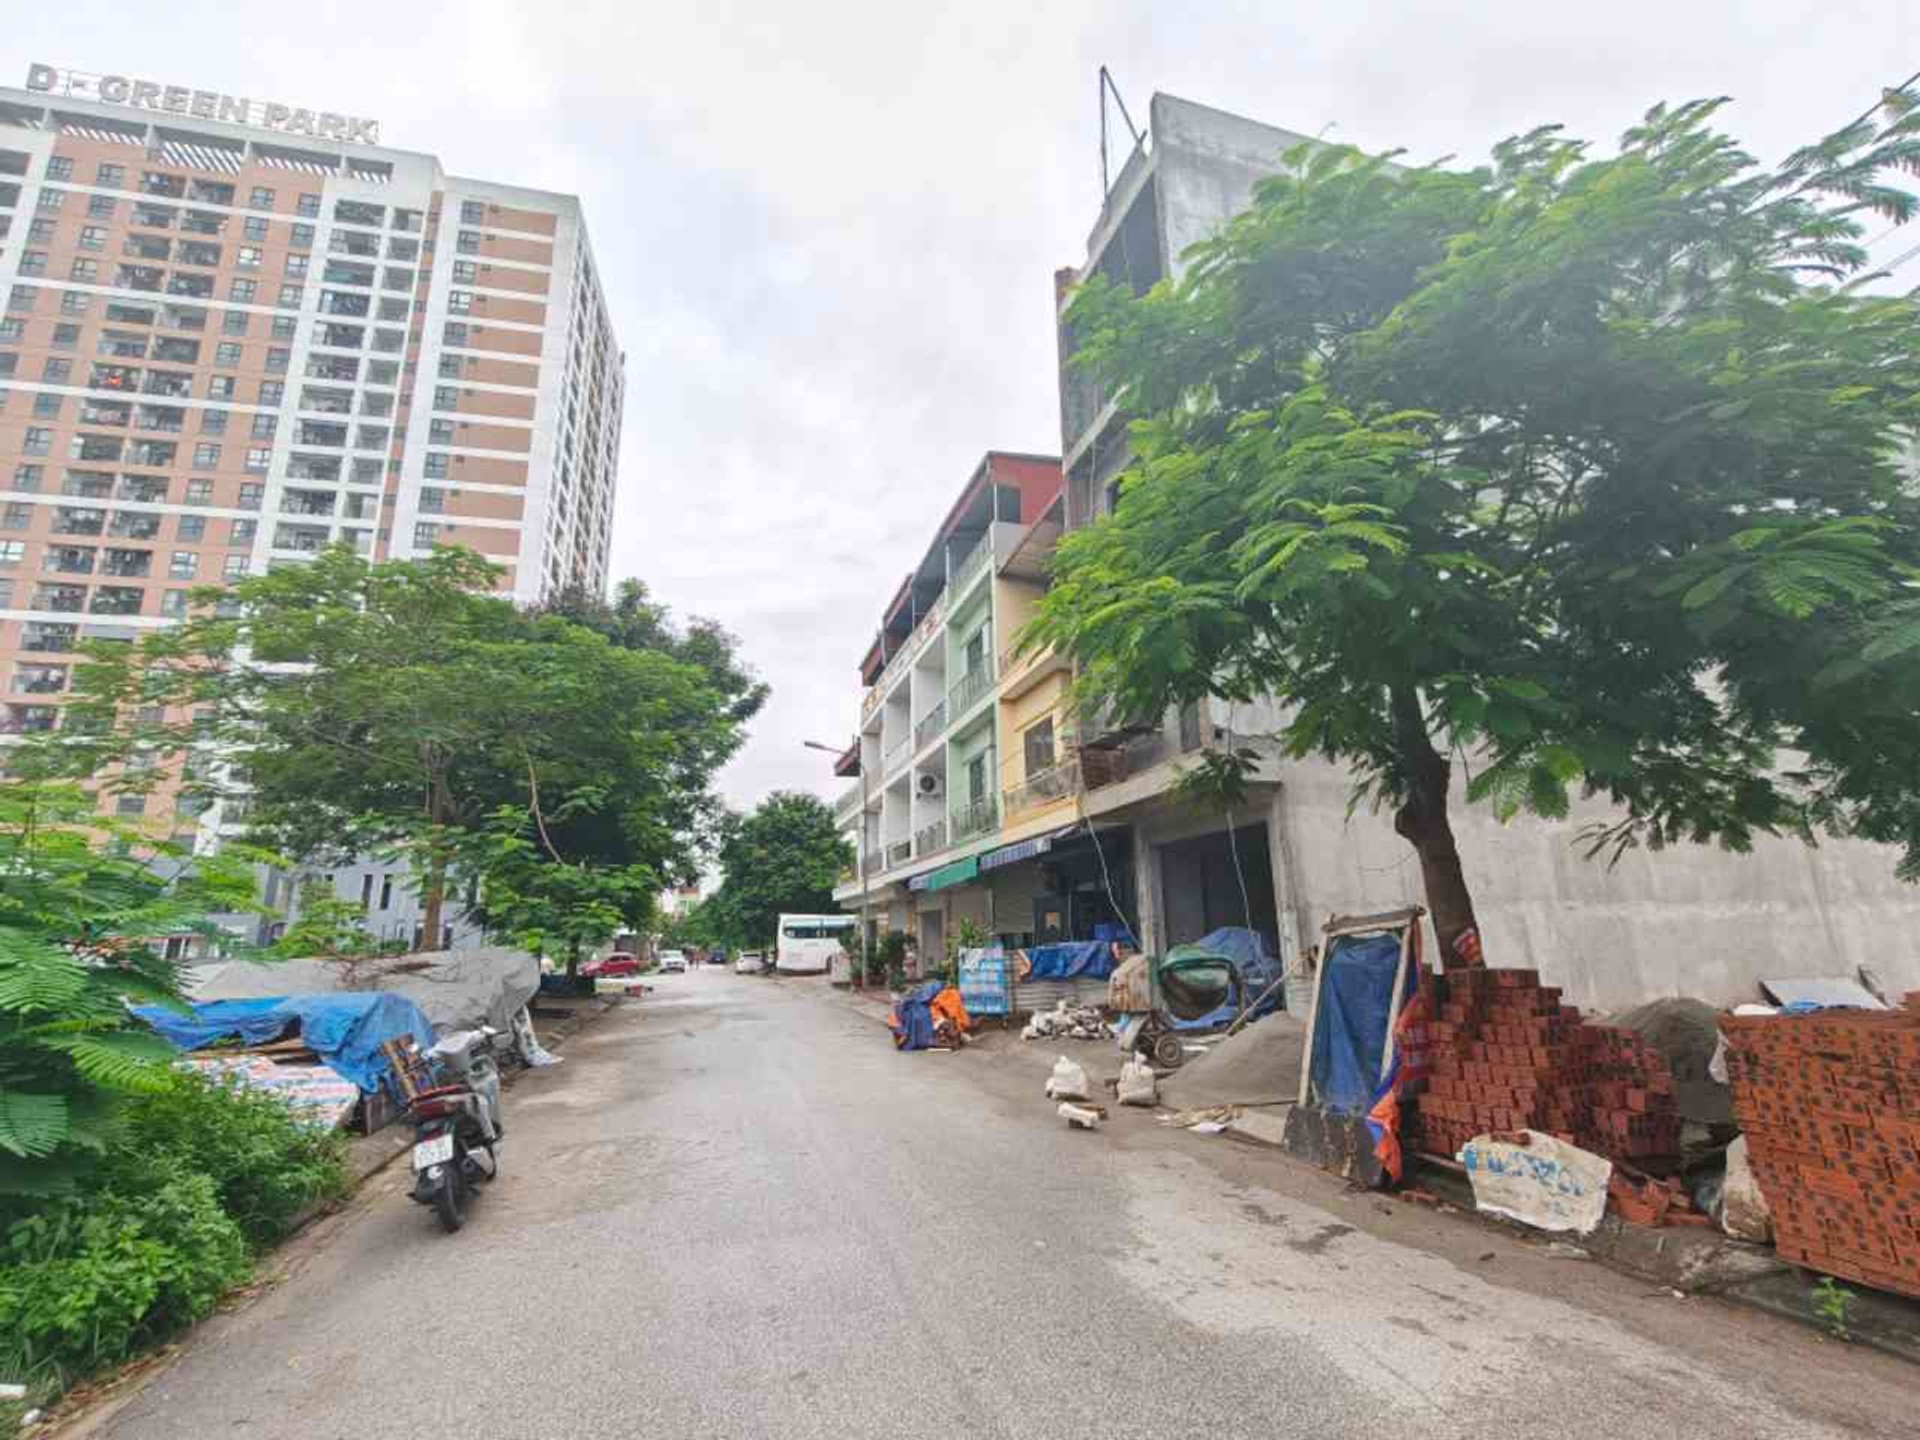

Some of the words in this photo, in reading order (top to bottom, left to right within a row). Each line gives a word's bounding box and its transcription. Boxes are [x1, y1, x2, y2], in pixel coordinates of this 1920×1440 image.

[26, 62, 58, 92] D
[98, 74, 249, 124] GREEN
[264, 101, 381, 146] PARK
